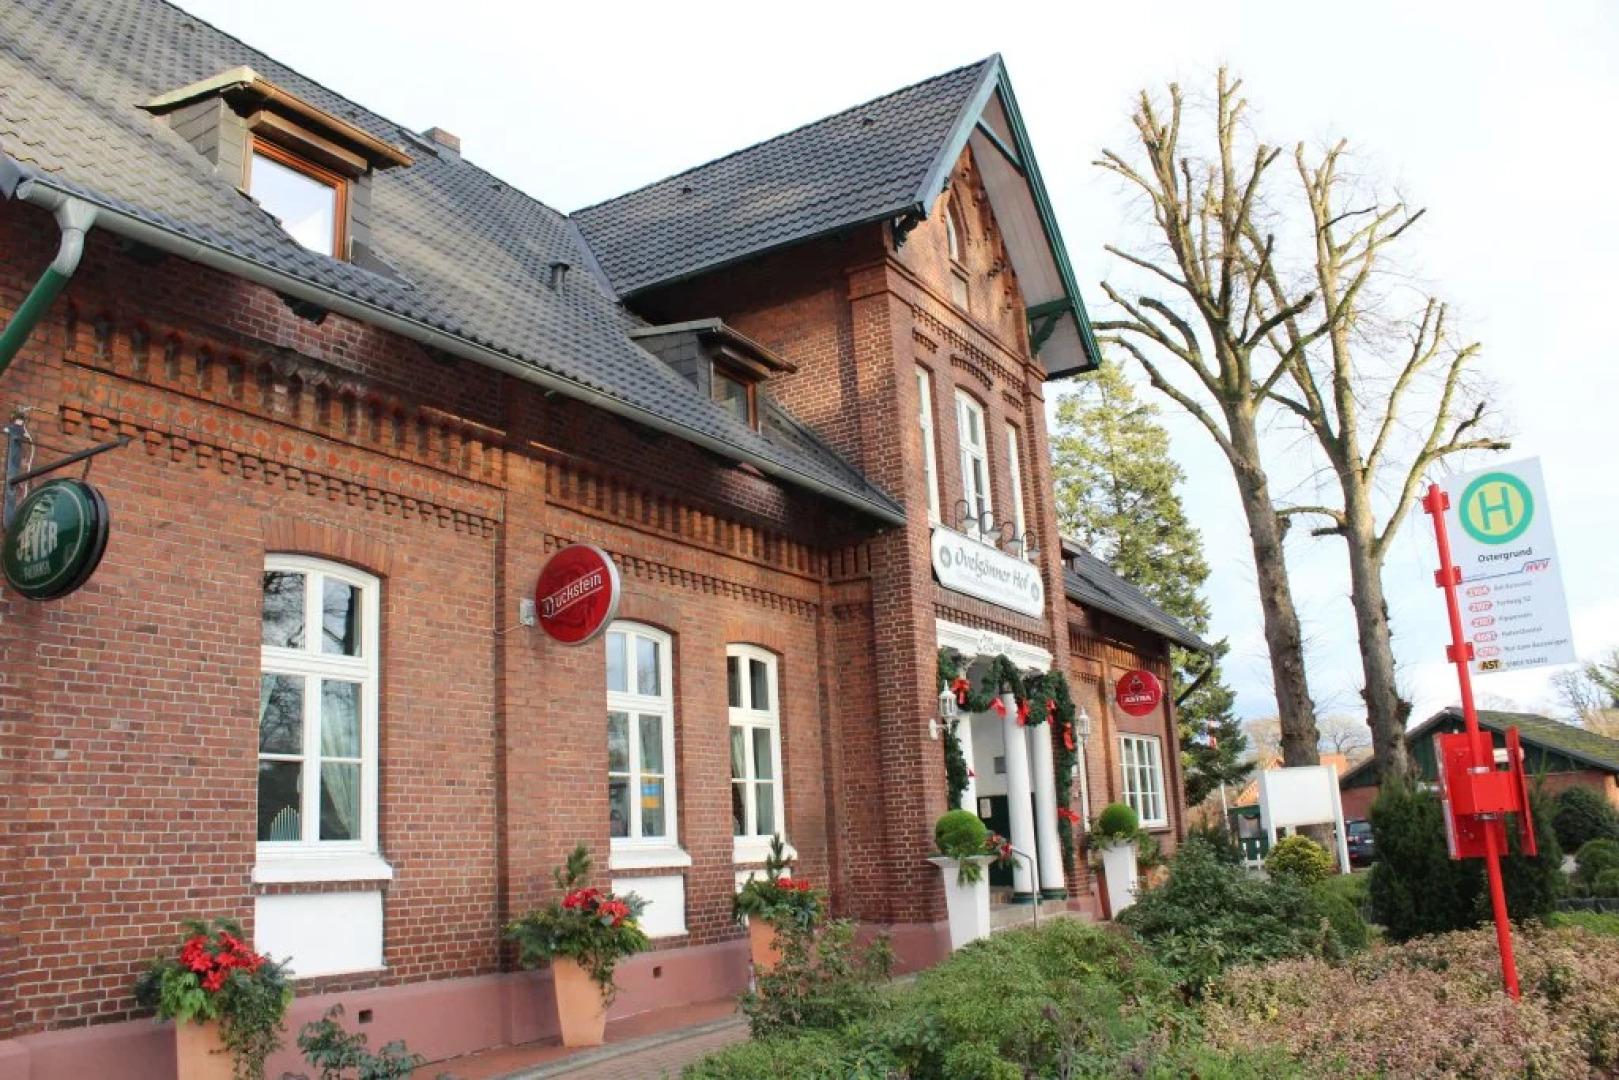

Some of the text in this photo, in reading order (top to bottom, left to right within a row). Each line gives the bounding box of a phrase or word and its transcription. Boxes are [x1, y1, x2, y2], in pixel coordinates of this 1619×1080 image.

[1478, 486, 1514, 530] H
[16, 518, 59, 563] JEVER
[1478, 547, 1532, 562] Ostergrund
[1525, 560, 1549, 572] HVV
[541, 573, 602, 618] Duckstein
[1482, 659, 1500, 671] AST
[1125, 694, 1152, 703] ASTRA
